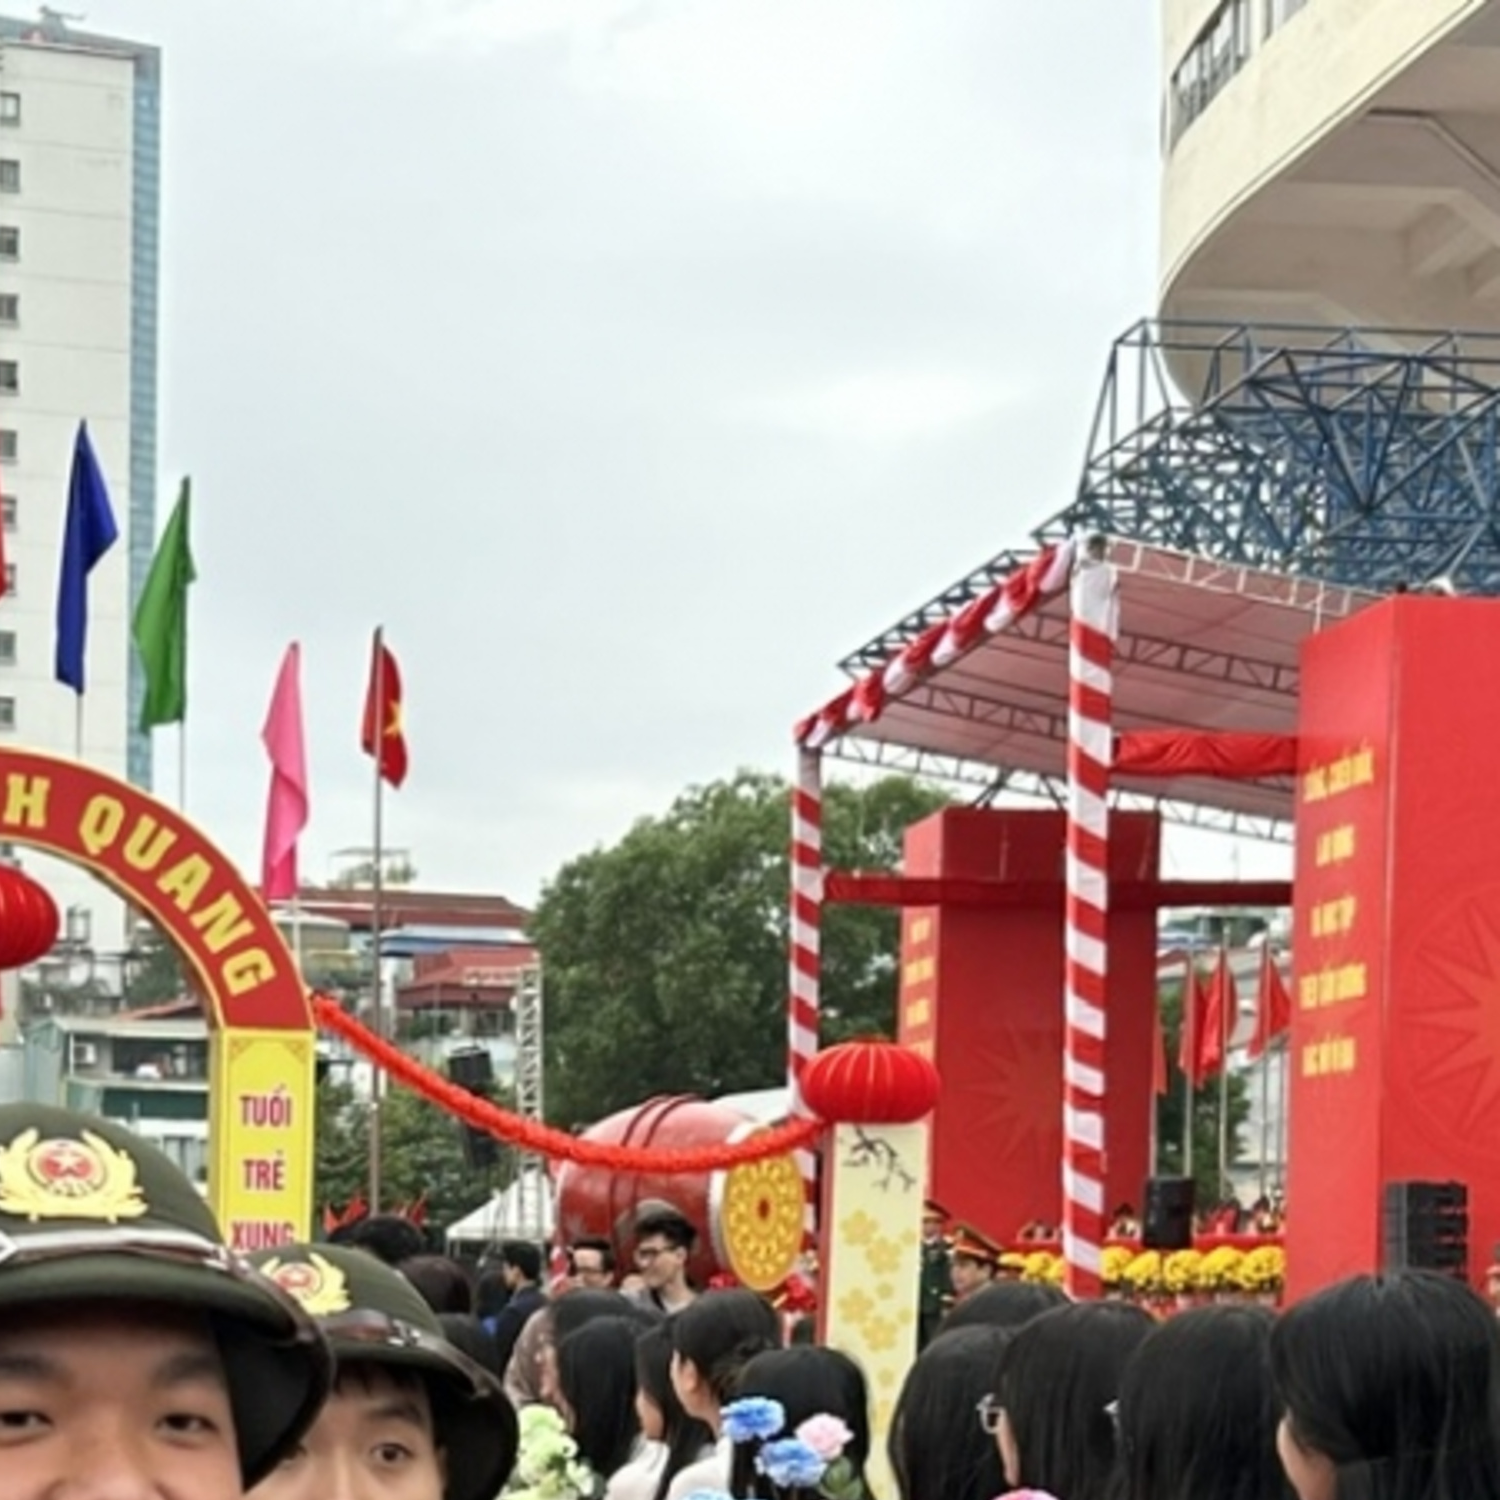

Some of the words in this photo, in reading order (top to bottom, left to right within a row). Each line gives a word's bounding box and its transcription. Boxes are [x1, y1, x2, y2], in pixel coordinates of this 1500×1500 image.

[78, 793, 277, 997] QUANG
[243, 1150, 285, 1191] TRẺ
[231, 1221, 295, 1250] XUNG
